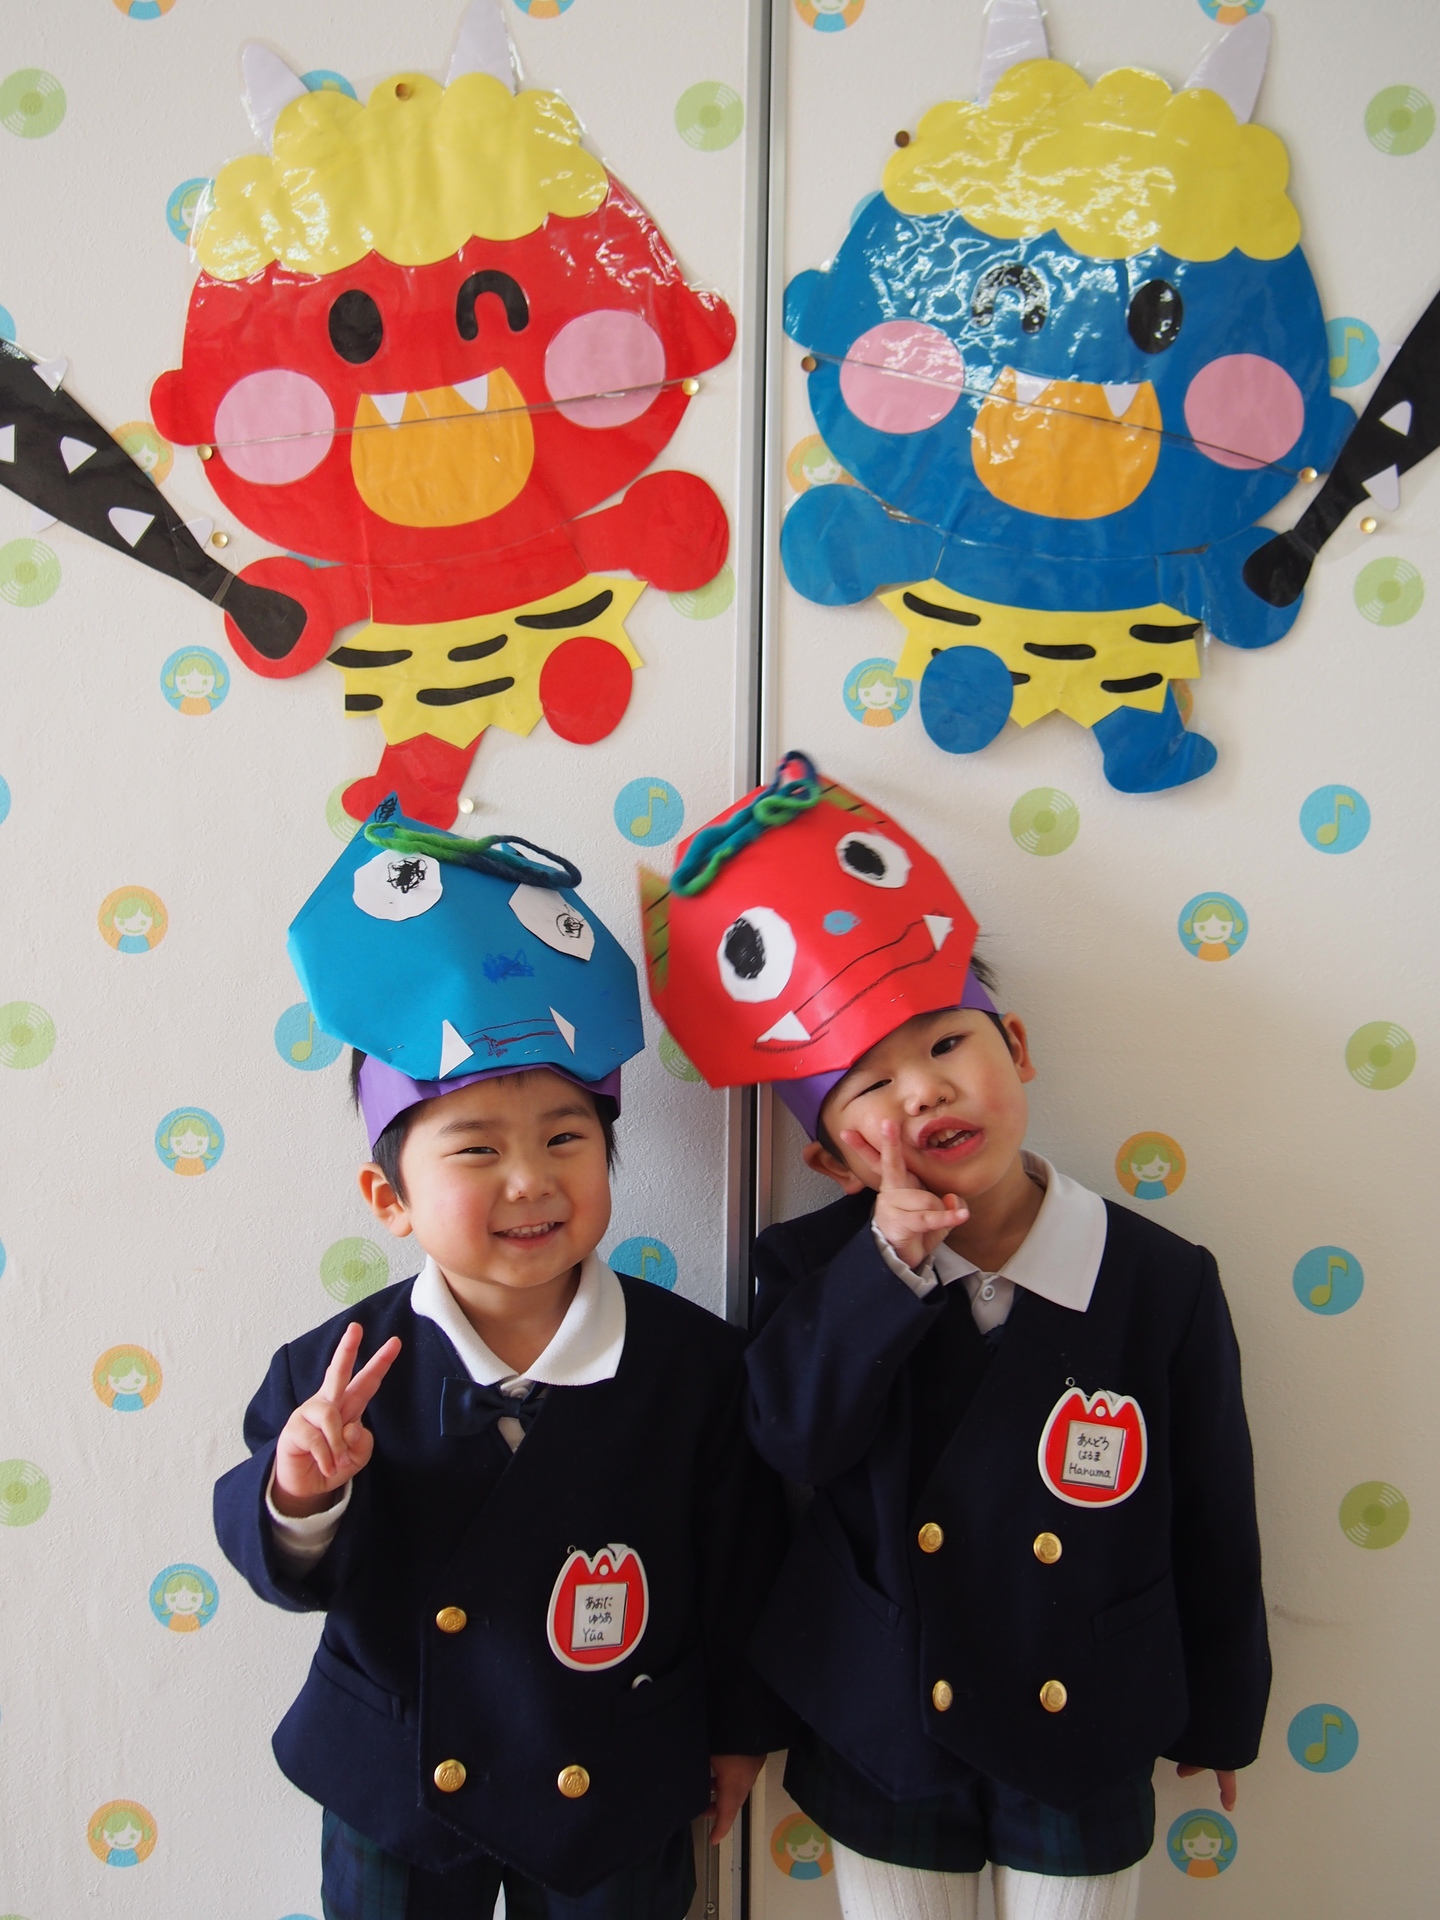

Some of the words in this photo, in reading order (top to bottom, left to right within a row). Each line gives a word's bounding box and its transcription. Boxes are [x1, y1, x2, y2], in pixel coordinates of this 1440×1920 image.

[1078, 1450, 1101, 1462] はるま
[1069, 1462, 1111, 1479] Haruma
